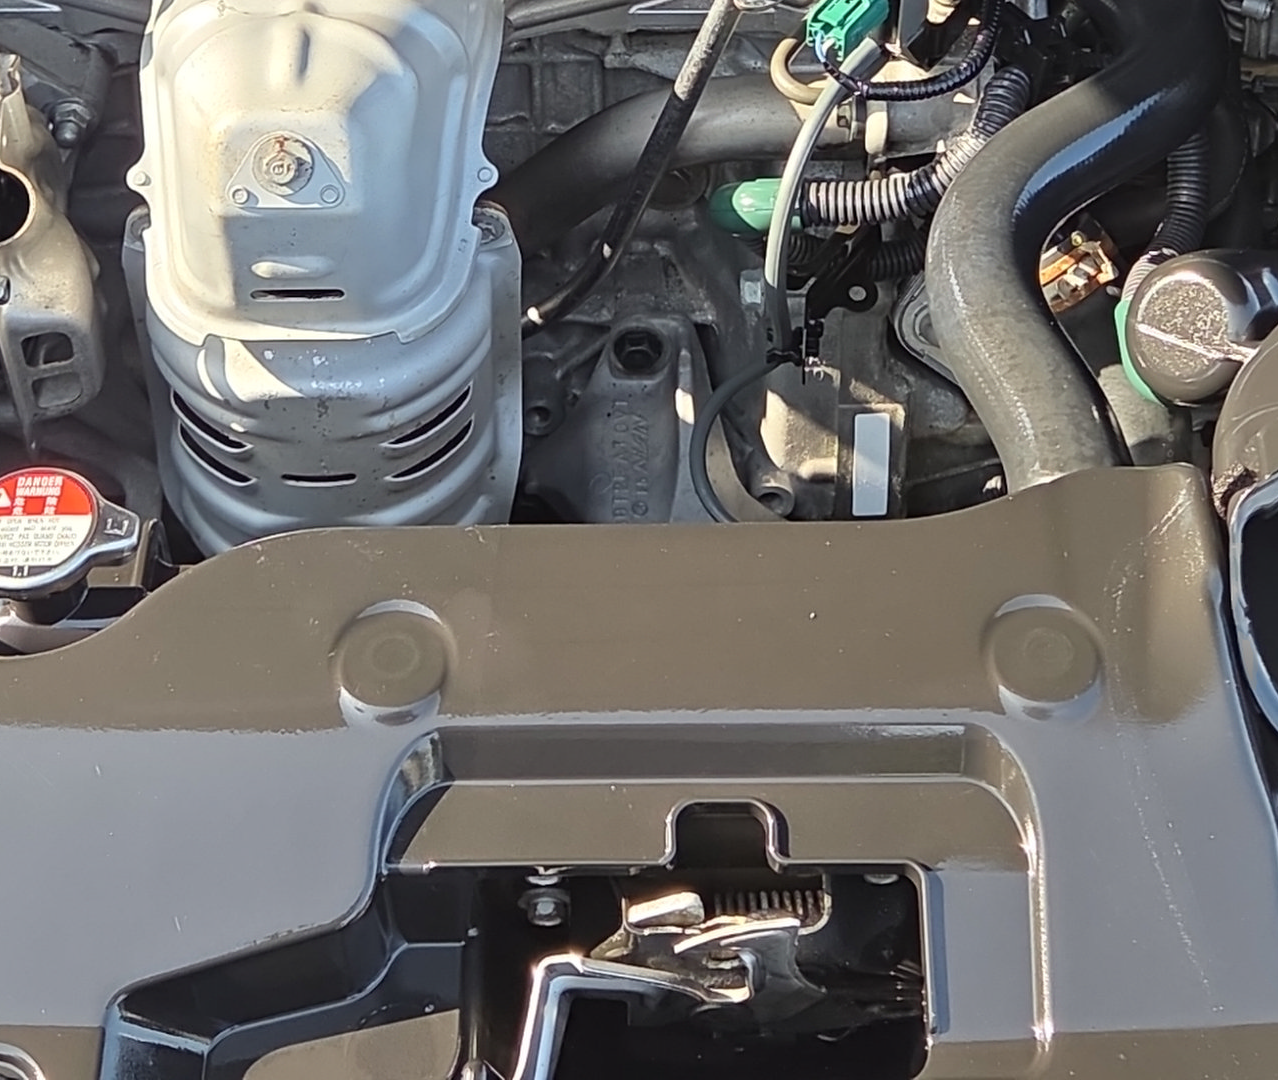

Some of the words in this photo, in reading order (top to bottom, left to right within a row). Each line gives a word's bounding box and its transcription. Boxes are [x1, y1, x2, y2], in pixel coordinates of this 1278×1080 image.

[17, 476, 63, 487] DANGER
[16, 486, 62, 497] WARNUNG
[12, 565, 29, 577] 1.1
